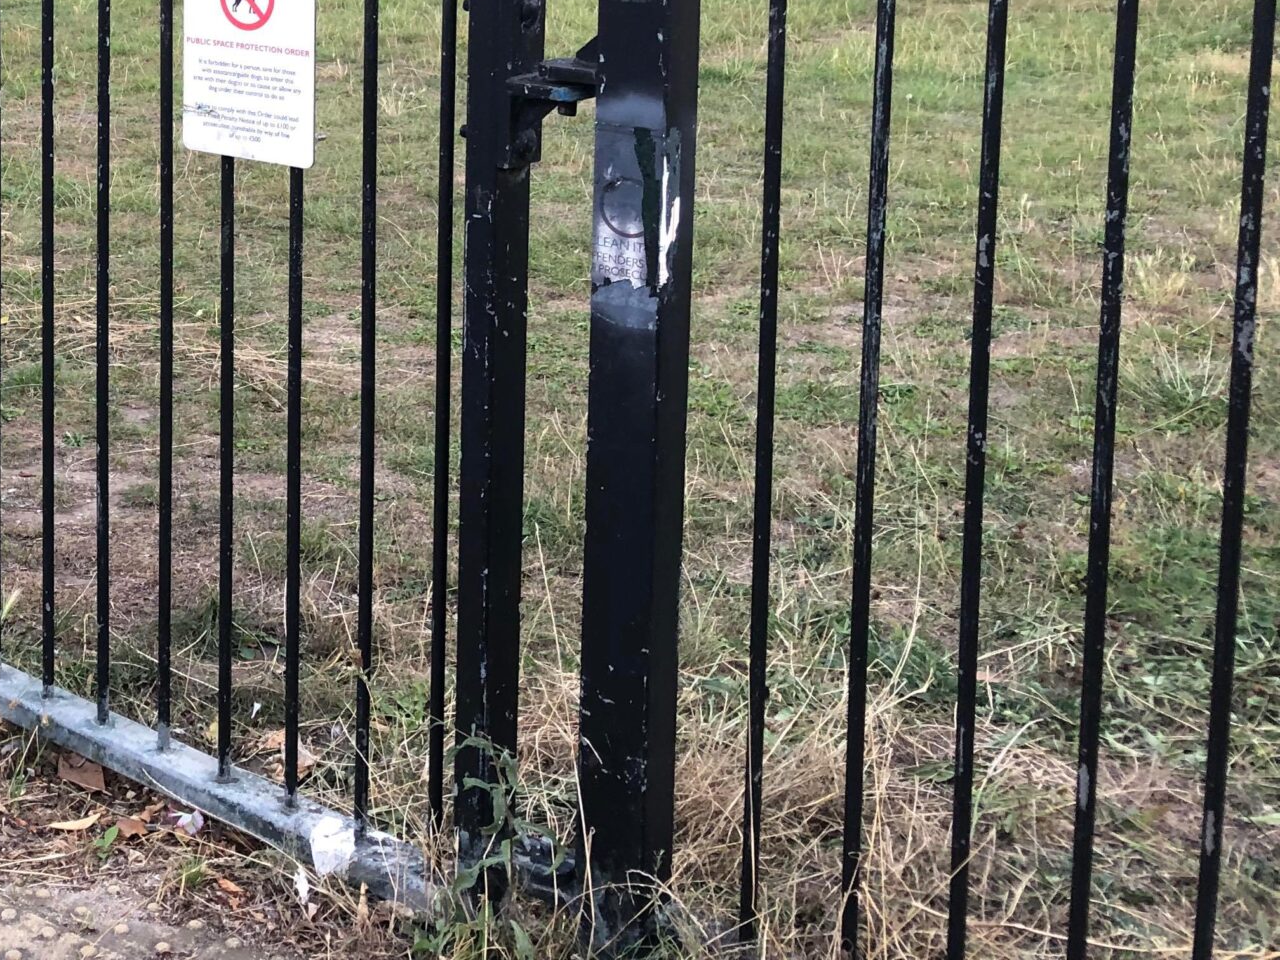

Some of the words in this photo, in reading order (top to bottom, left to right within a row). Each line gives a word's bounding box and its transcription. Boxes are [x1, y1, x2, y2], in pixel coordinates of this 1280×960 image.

[186, 37, 210, 45] PUBLIC
[212, 40, 234, 48] SPACE
[236, 43, 282, 53] PROTECTION
[284, 48, 309, 57] ORDER
